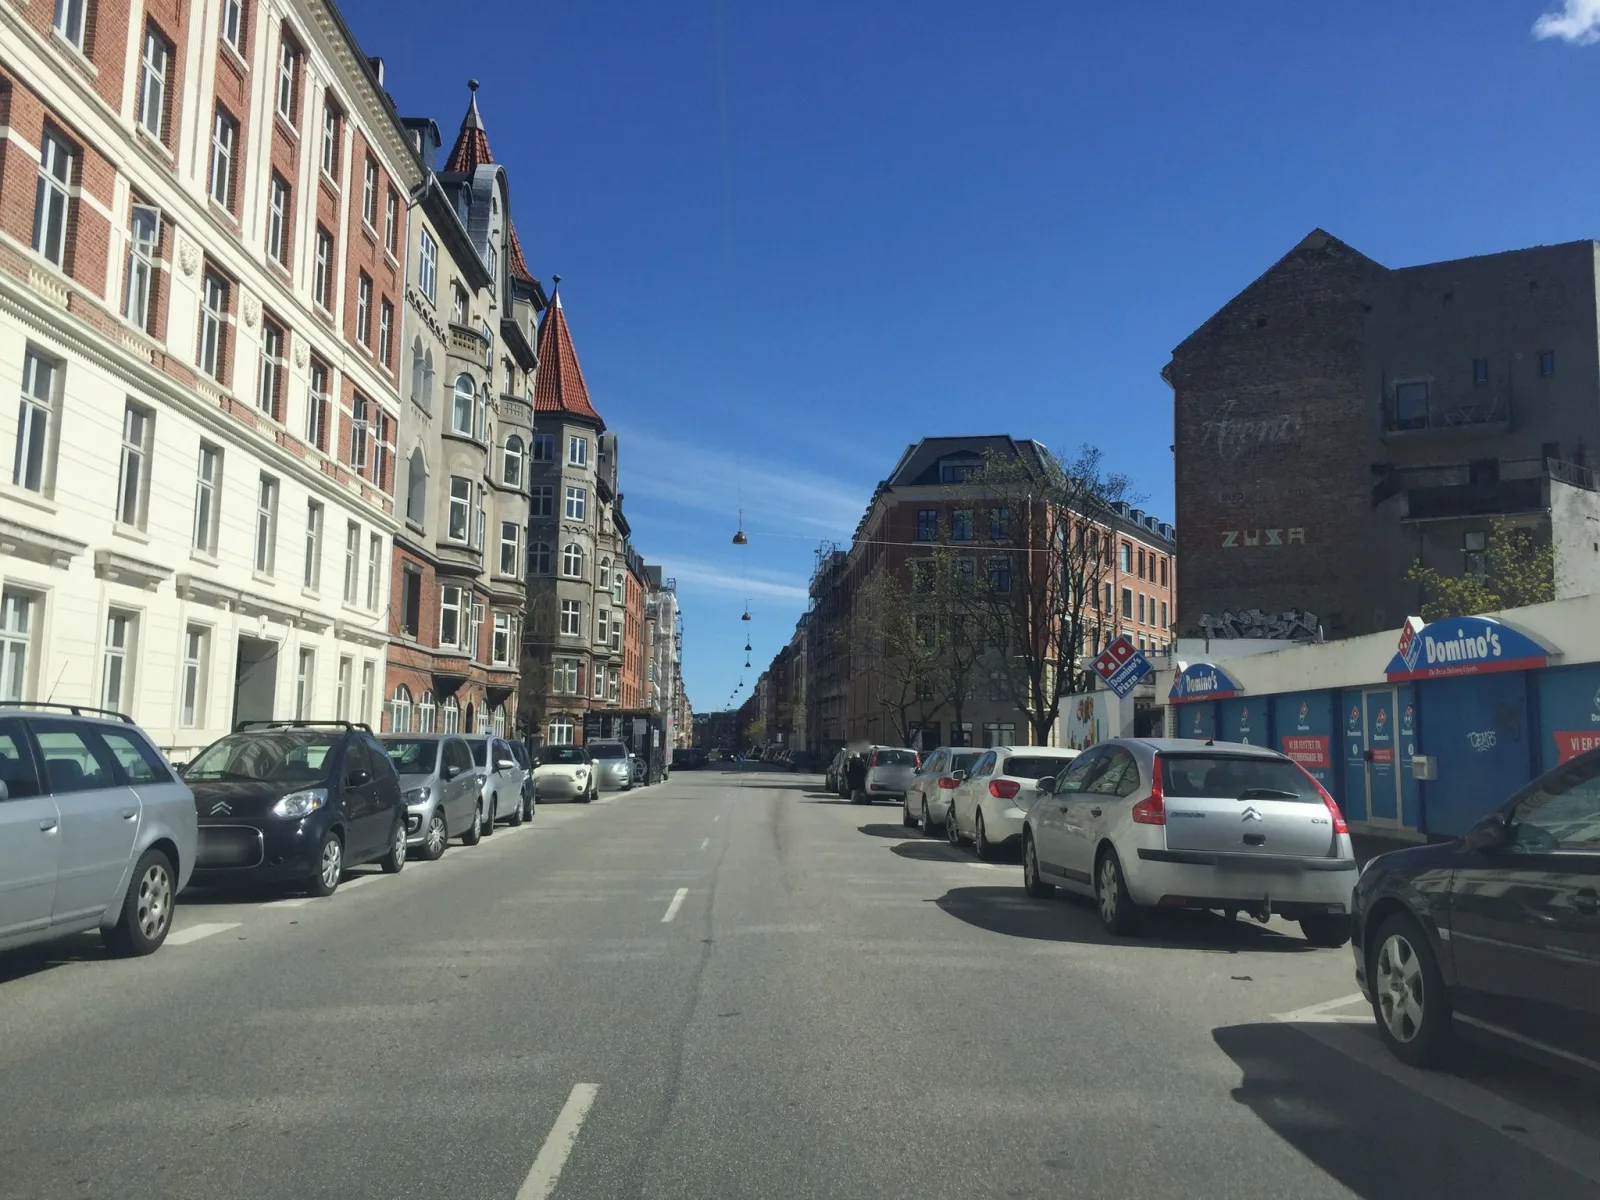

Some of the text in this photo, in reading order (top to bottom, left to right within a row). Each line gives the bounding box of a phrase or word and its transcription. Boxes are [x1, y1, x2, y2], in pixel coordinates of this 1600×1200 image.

[1425, 627, 1501, 663] Domino's
[1110, 657, 1142, 687] Domino's
[1186, 670, 1218, 693] Domino's
[1117, 674, 1139, 694] Pizza
[1571, 737, 1580, 750] VI
[1581, 737, 1593, 751] ER
